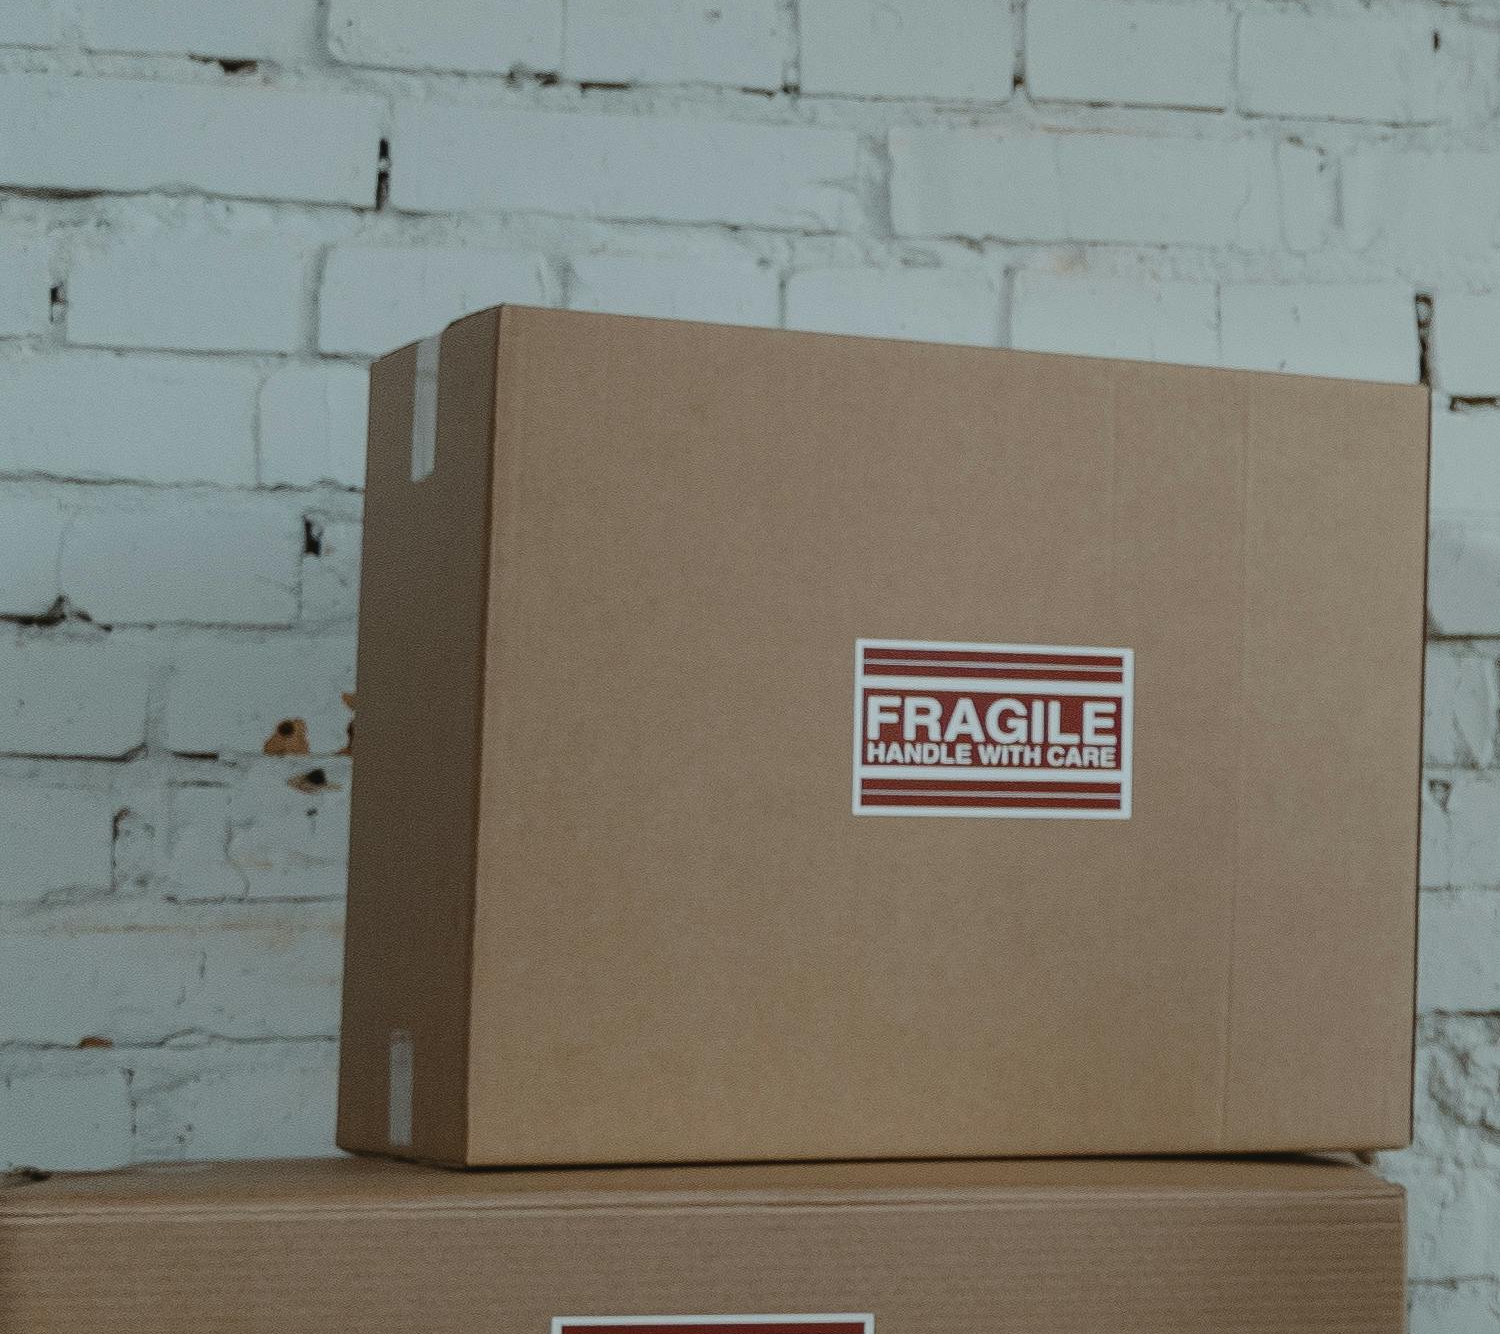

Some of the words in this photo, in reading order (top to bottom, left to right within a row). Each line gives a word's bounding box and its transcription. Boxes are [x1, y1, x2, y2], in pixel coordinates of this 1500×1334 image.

[867, 696, 1117, 745] FRAGILE
[867, 741, 972, 765] HANDLE
[978, 744, 1041, 767] WITH
[1047, 745, 1117, 768] CARE
